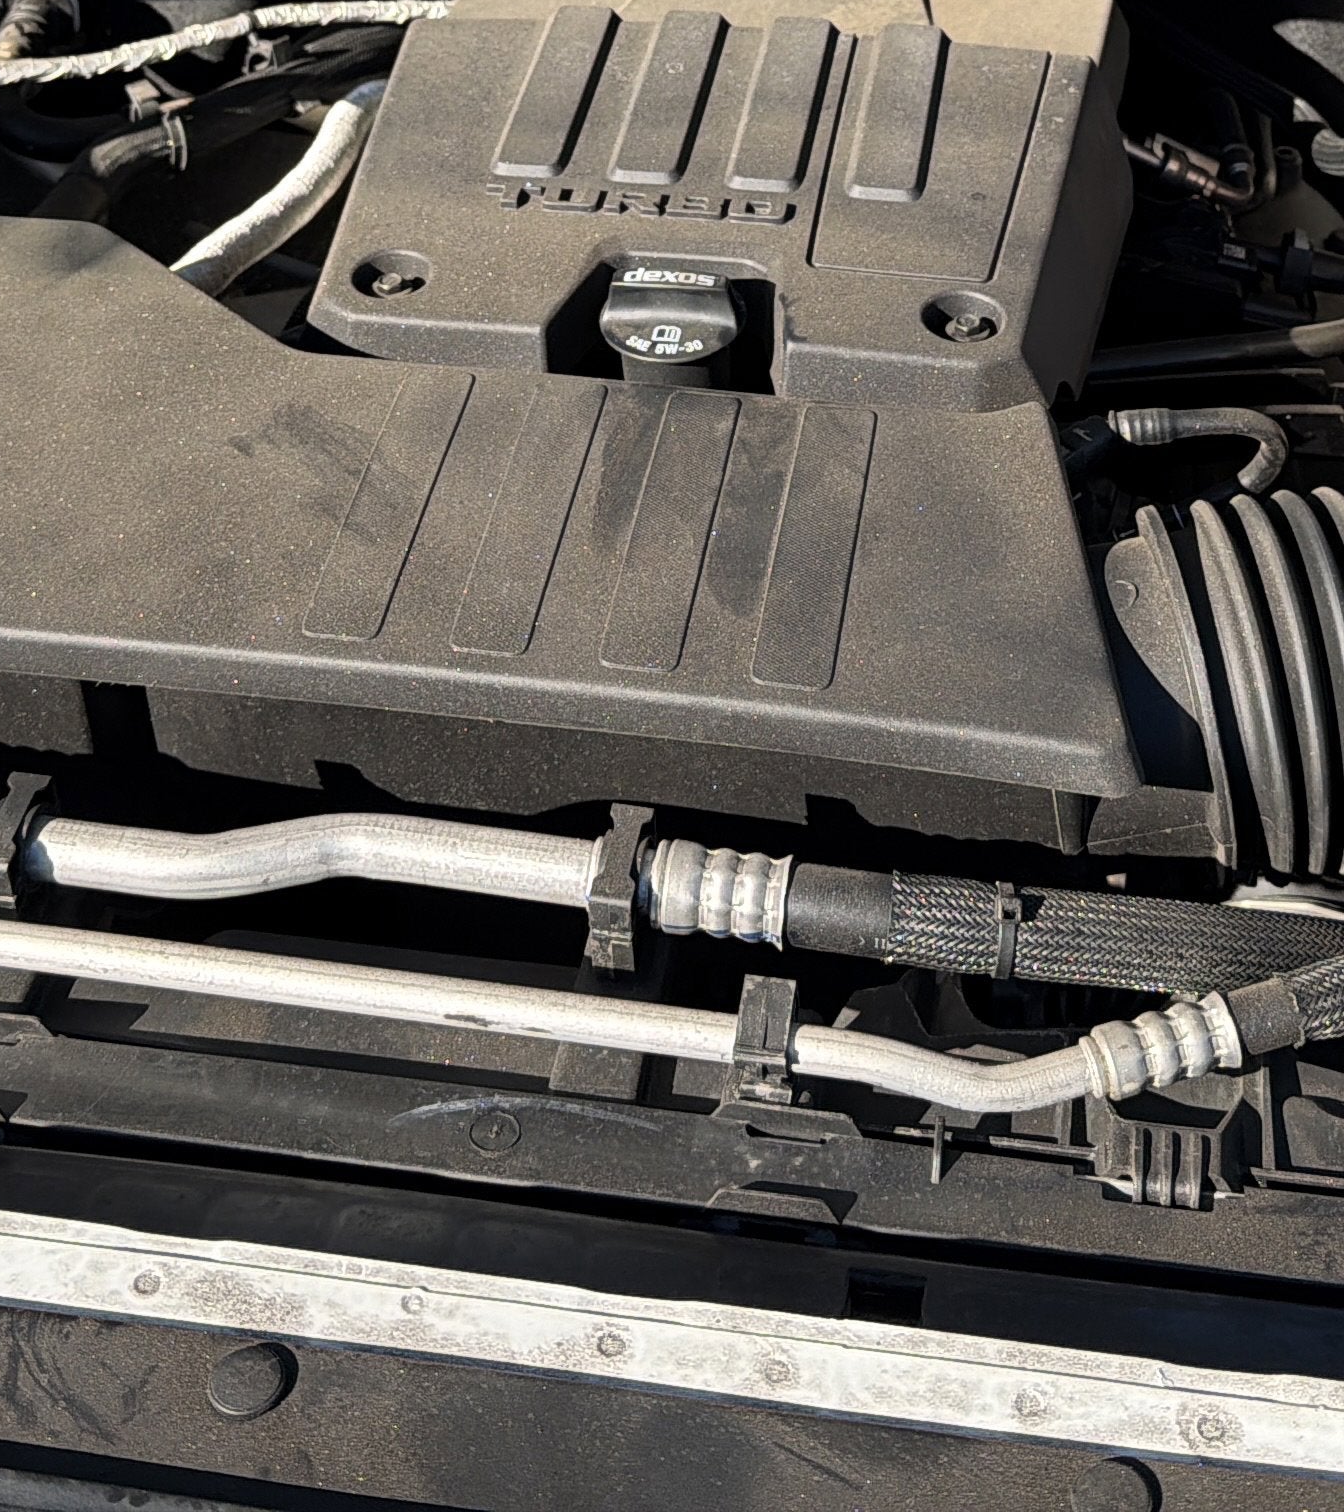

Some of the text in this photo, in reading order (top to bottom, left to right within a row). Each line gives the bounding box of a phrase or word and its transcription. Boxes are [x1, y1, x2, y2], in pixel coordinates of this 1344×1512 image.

[487, 183, 797, 226] TURBO
[623, 267, 716, 287] dexos
[625, 335, 704, 355] SAE 5W-30
